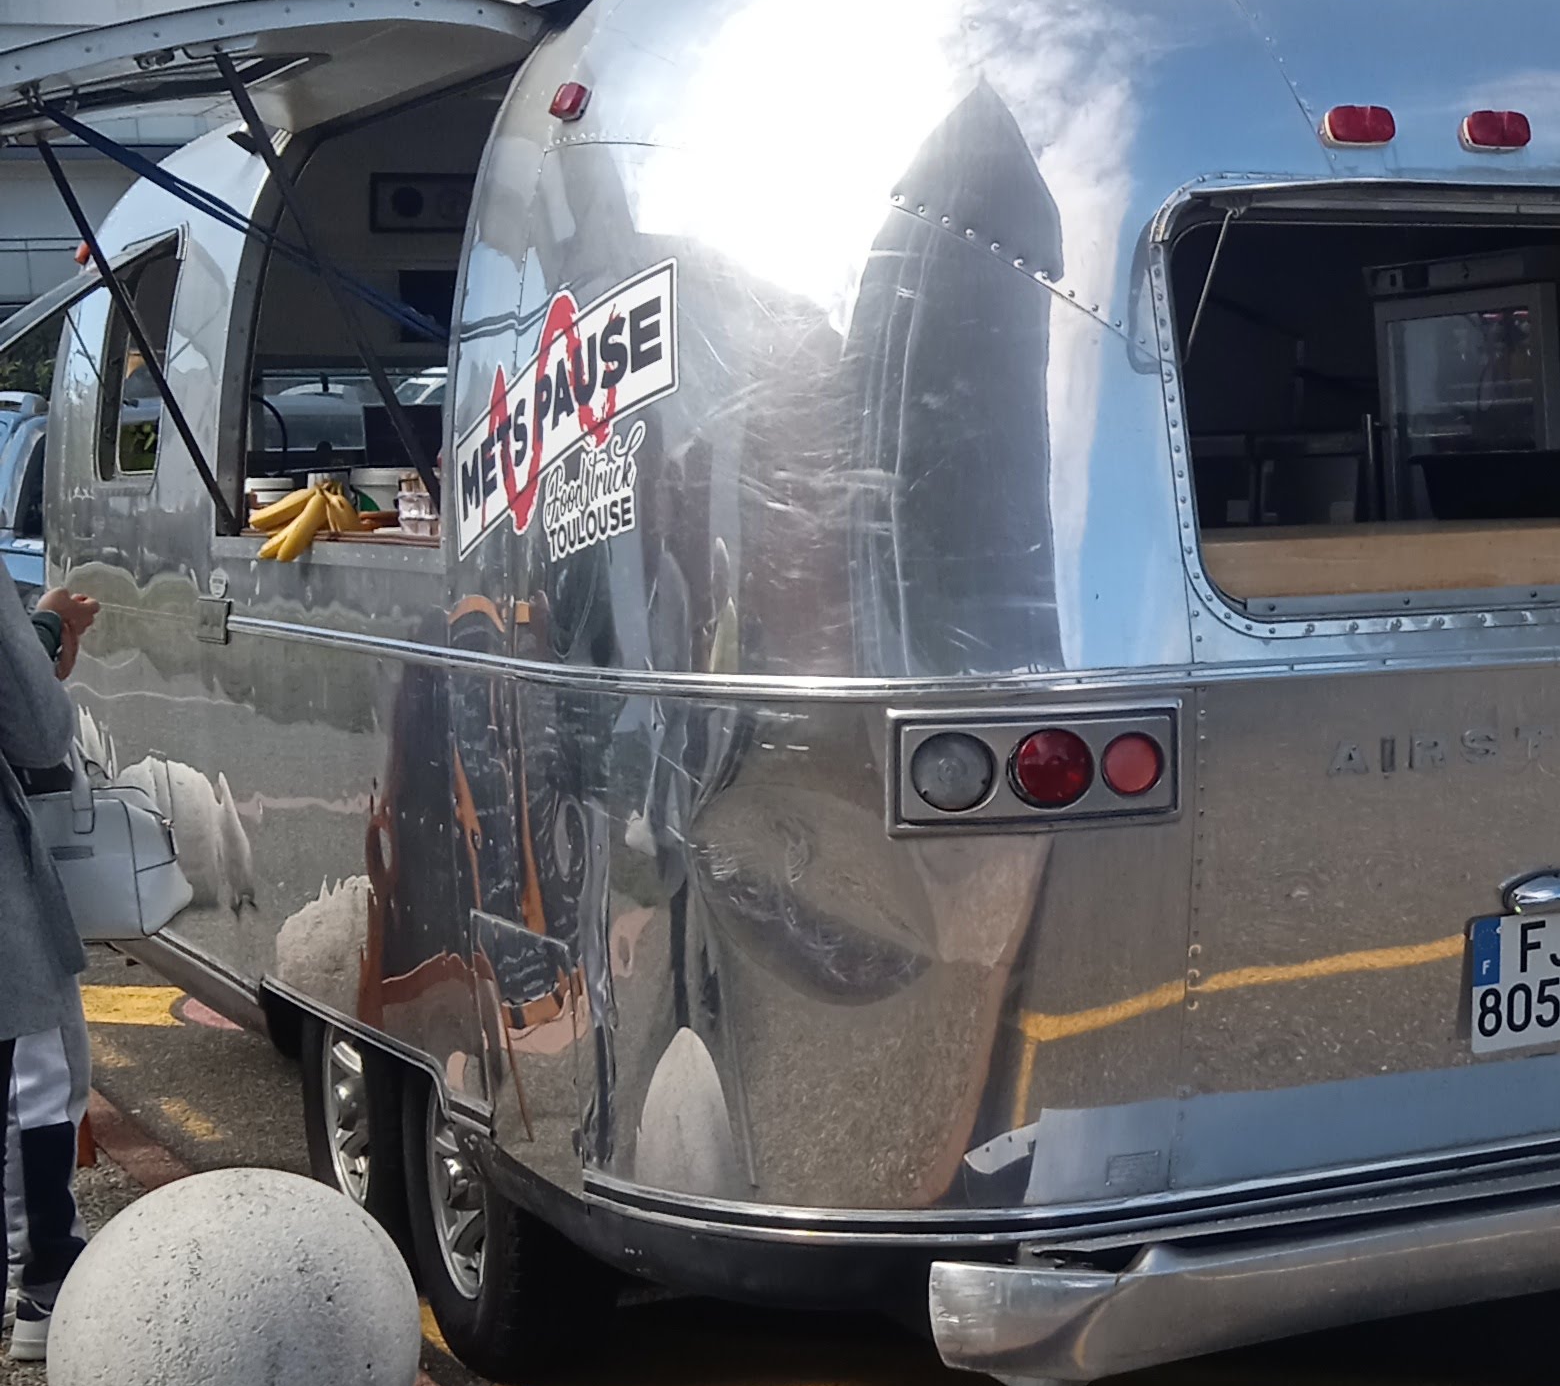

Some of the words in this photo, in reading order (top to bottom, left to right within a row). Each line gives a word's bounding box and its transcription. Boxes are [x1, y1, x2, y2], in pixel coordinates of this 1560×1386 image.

[460, 398, 528, 522] METS
[535, 295, 663, 442] PAUSE
[549, 495, 634, 559] TOULOUSE
[1481, 959, 1492, 976] F
